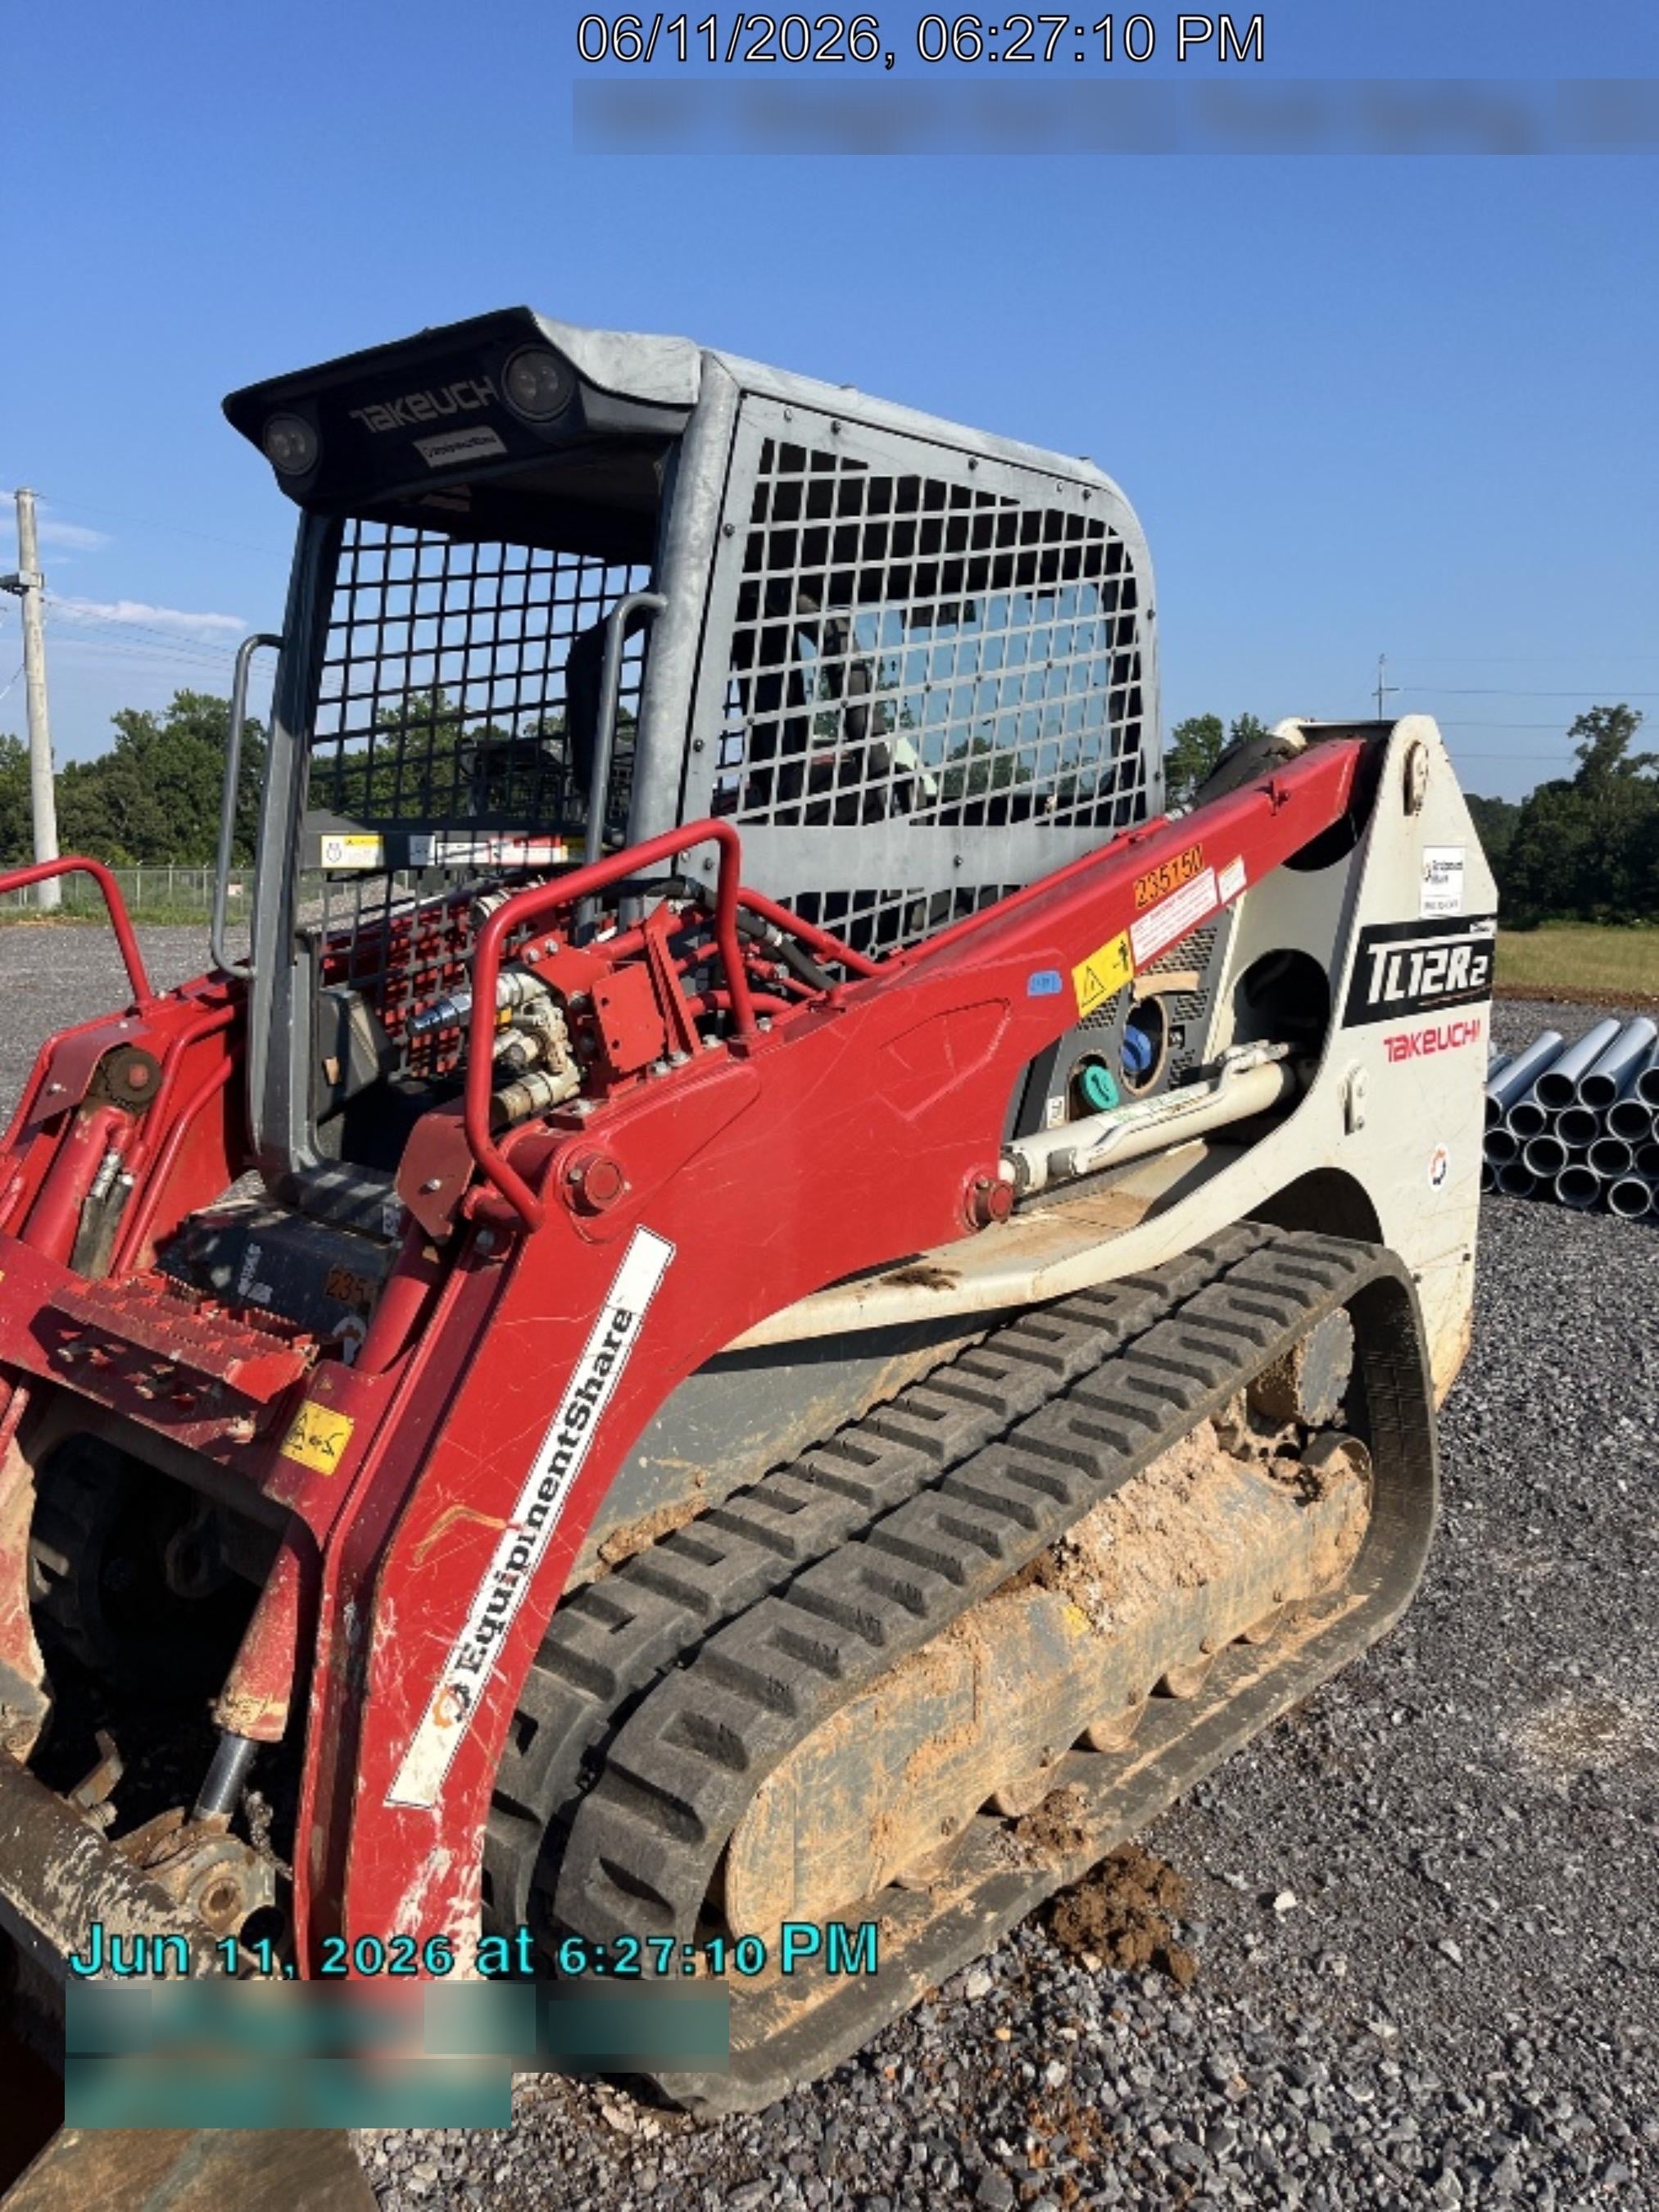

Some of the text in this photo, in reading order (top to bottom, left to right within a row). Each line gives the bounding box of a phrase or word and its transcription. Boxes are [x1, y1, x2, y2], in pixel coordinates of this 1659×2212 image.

[347, 375, 500, 433] TAKEUCH
[1136, 845, 1203, 907] 235150
[325, 1270, 368, 1302] 235
